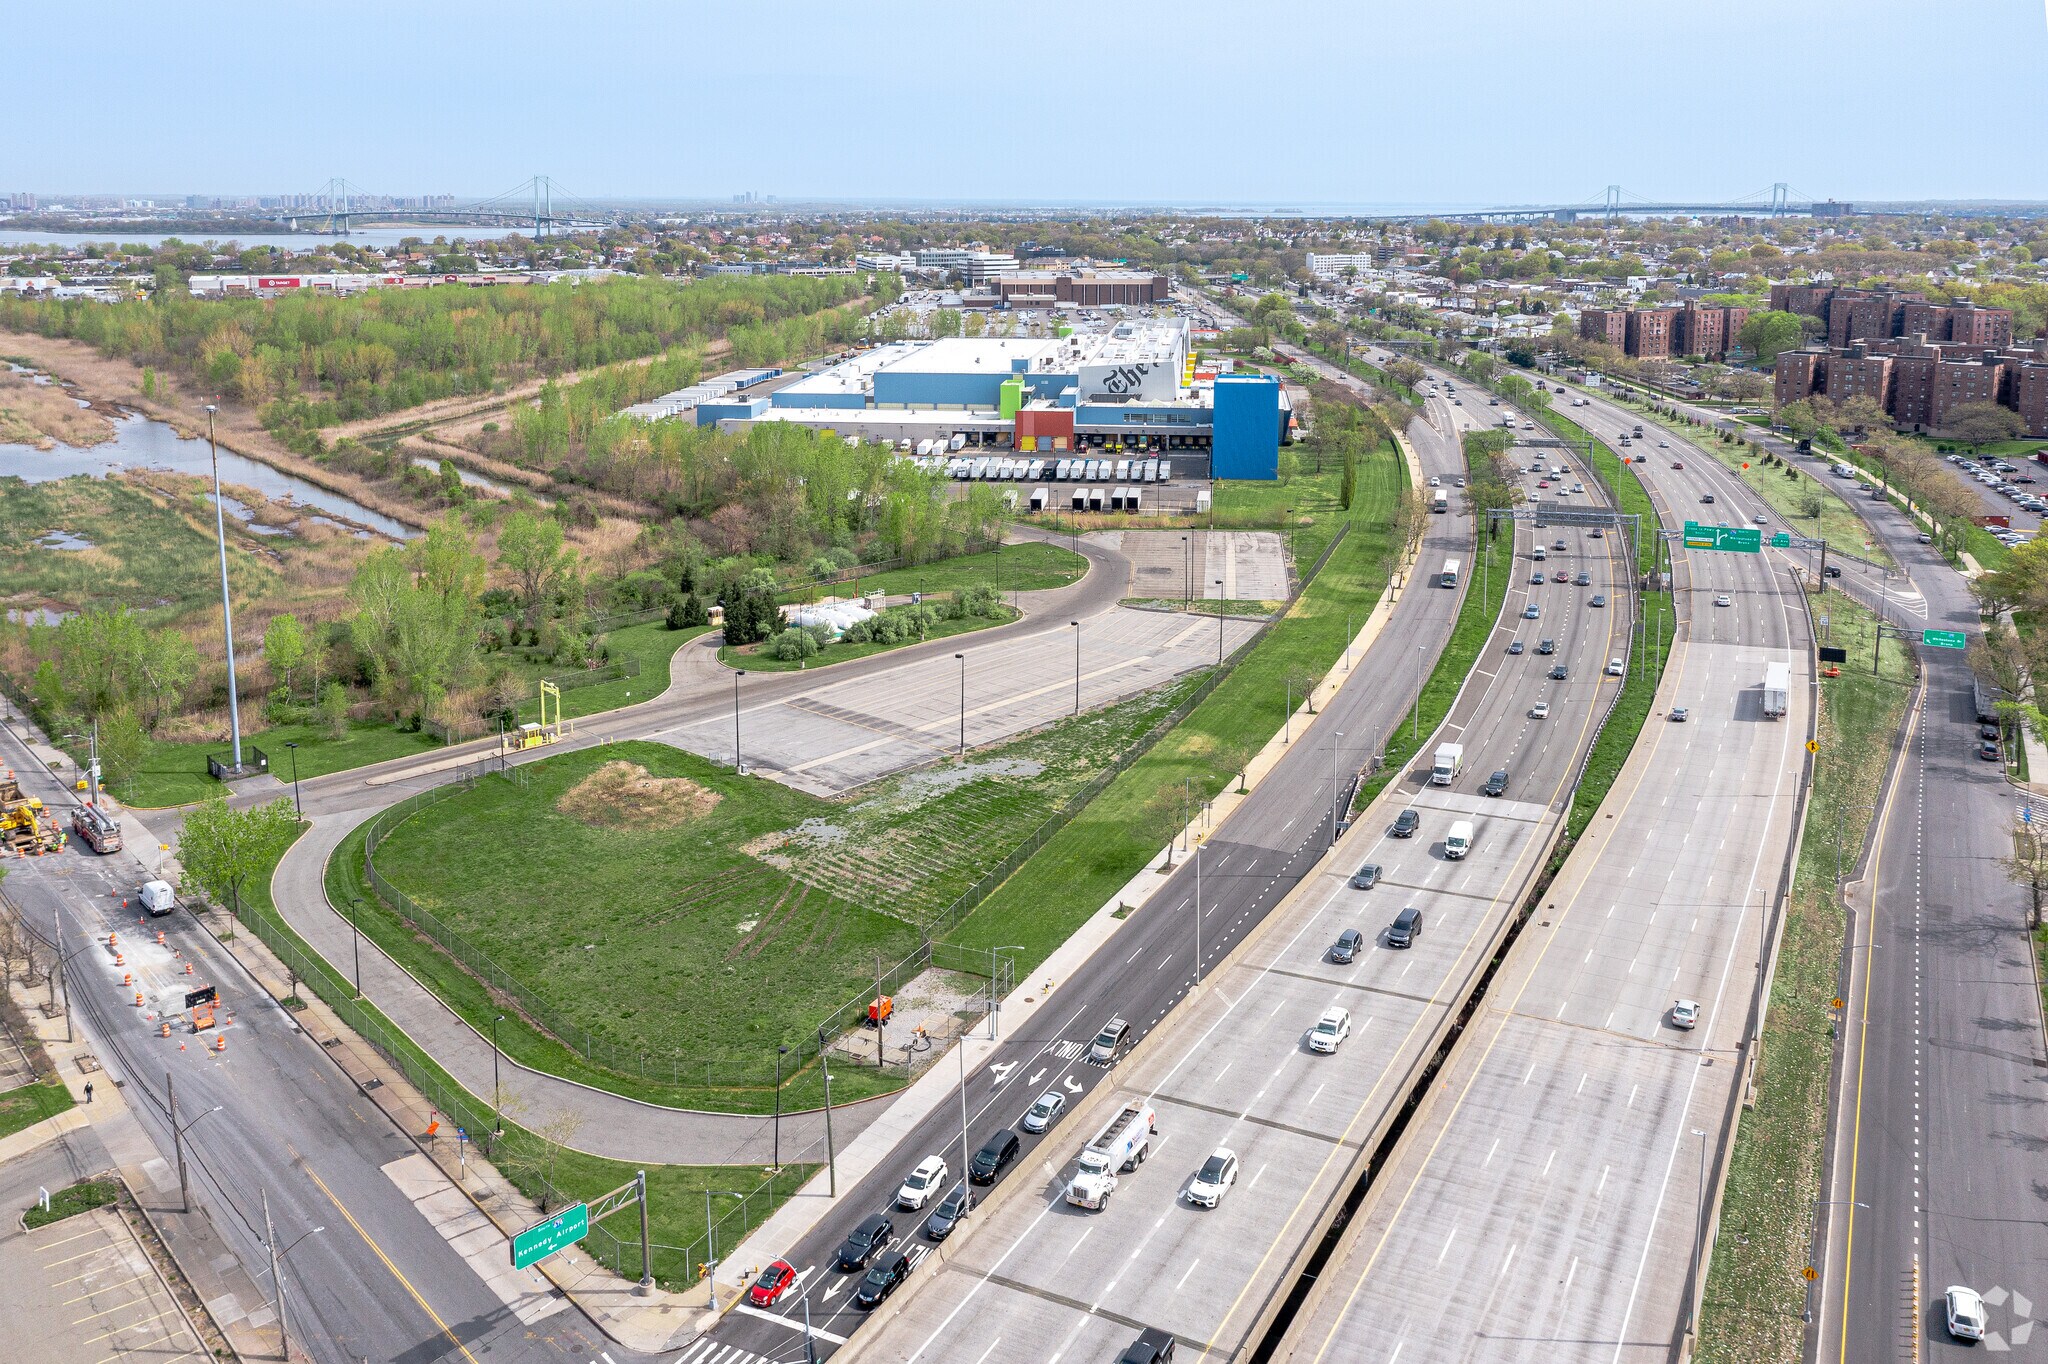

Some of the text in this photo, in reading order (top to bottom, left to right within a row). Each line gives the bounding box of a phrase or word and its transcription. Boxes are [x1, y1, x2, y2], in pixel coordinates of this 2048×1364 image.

[1103, 363, 1149, 393] The
[1043, 1039, 1084, 1060] ONLY
[518, 1219, 585, 1257] Kennedy Airport
